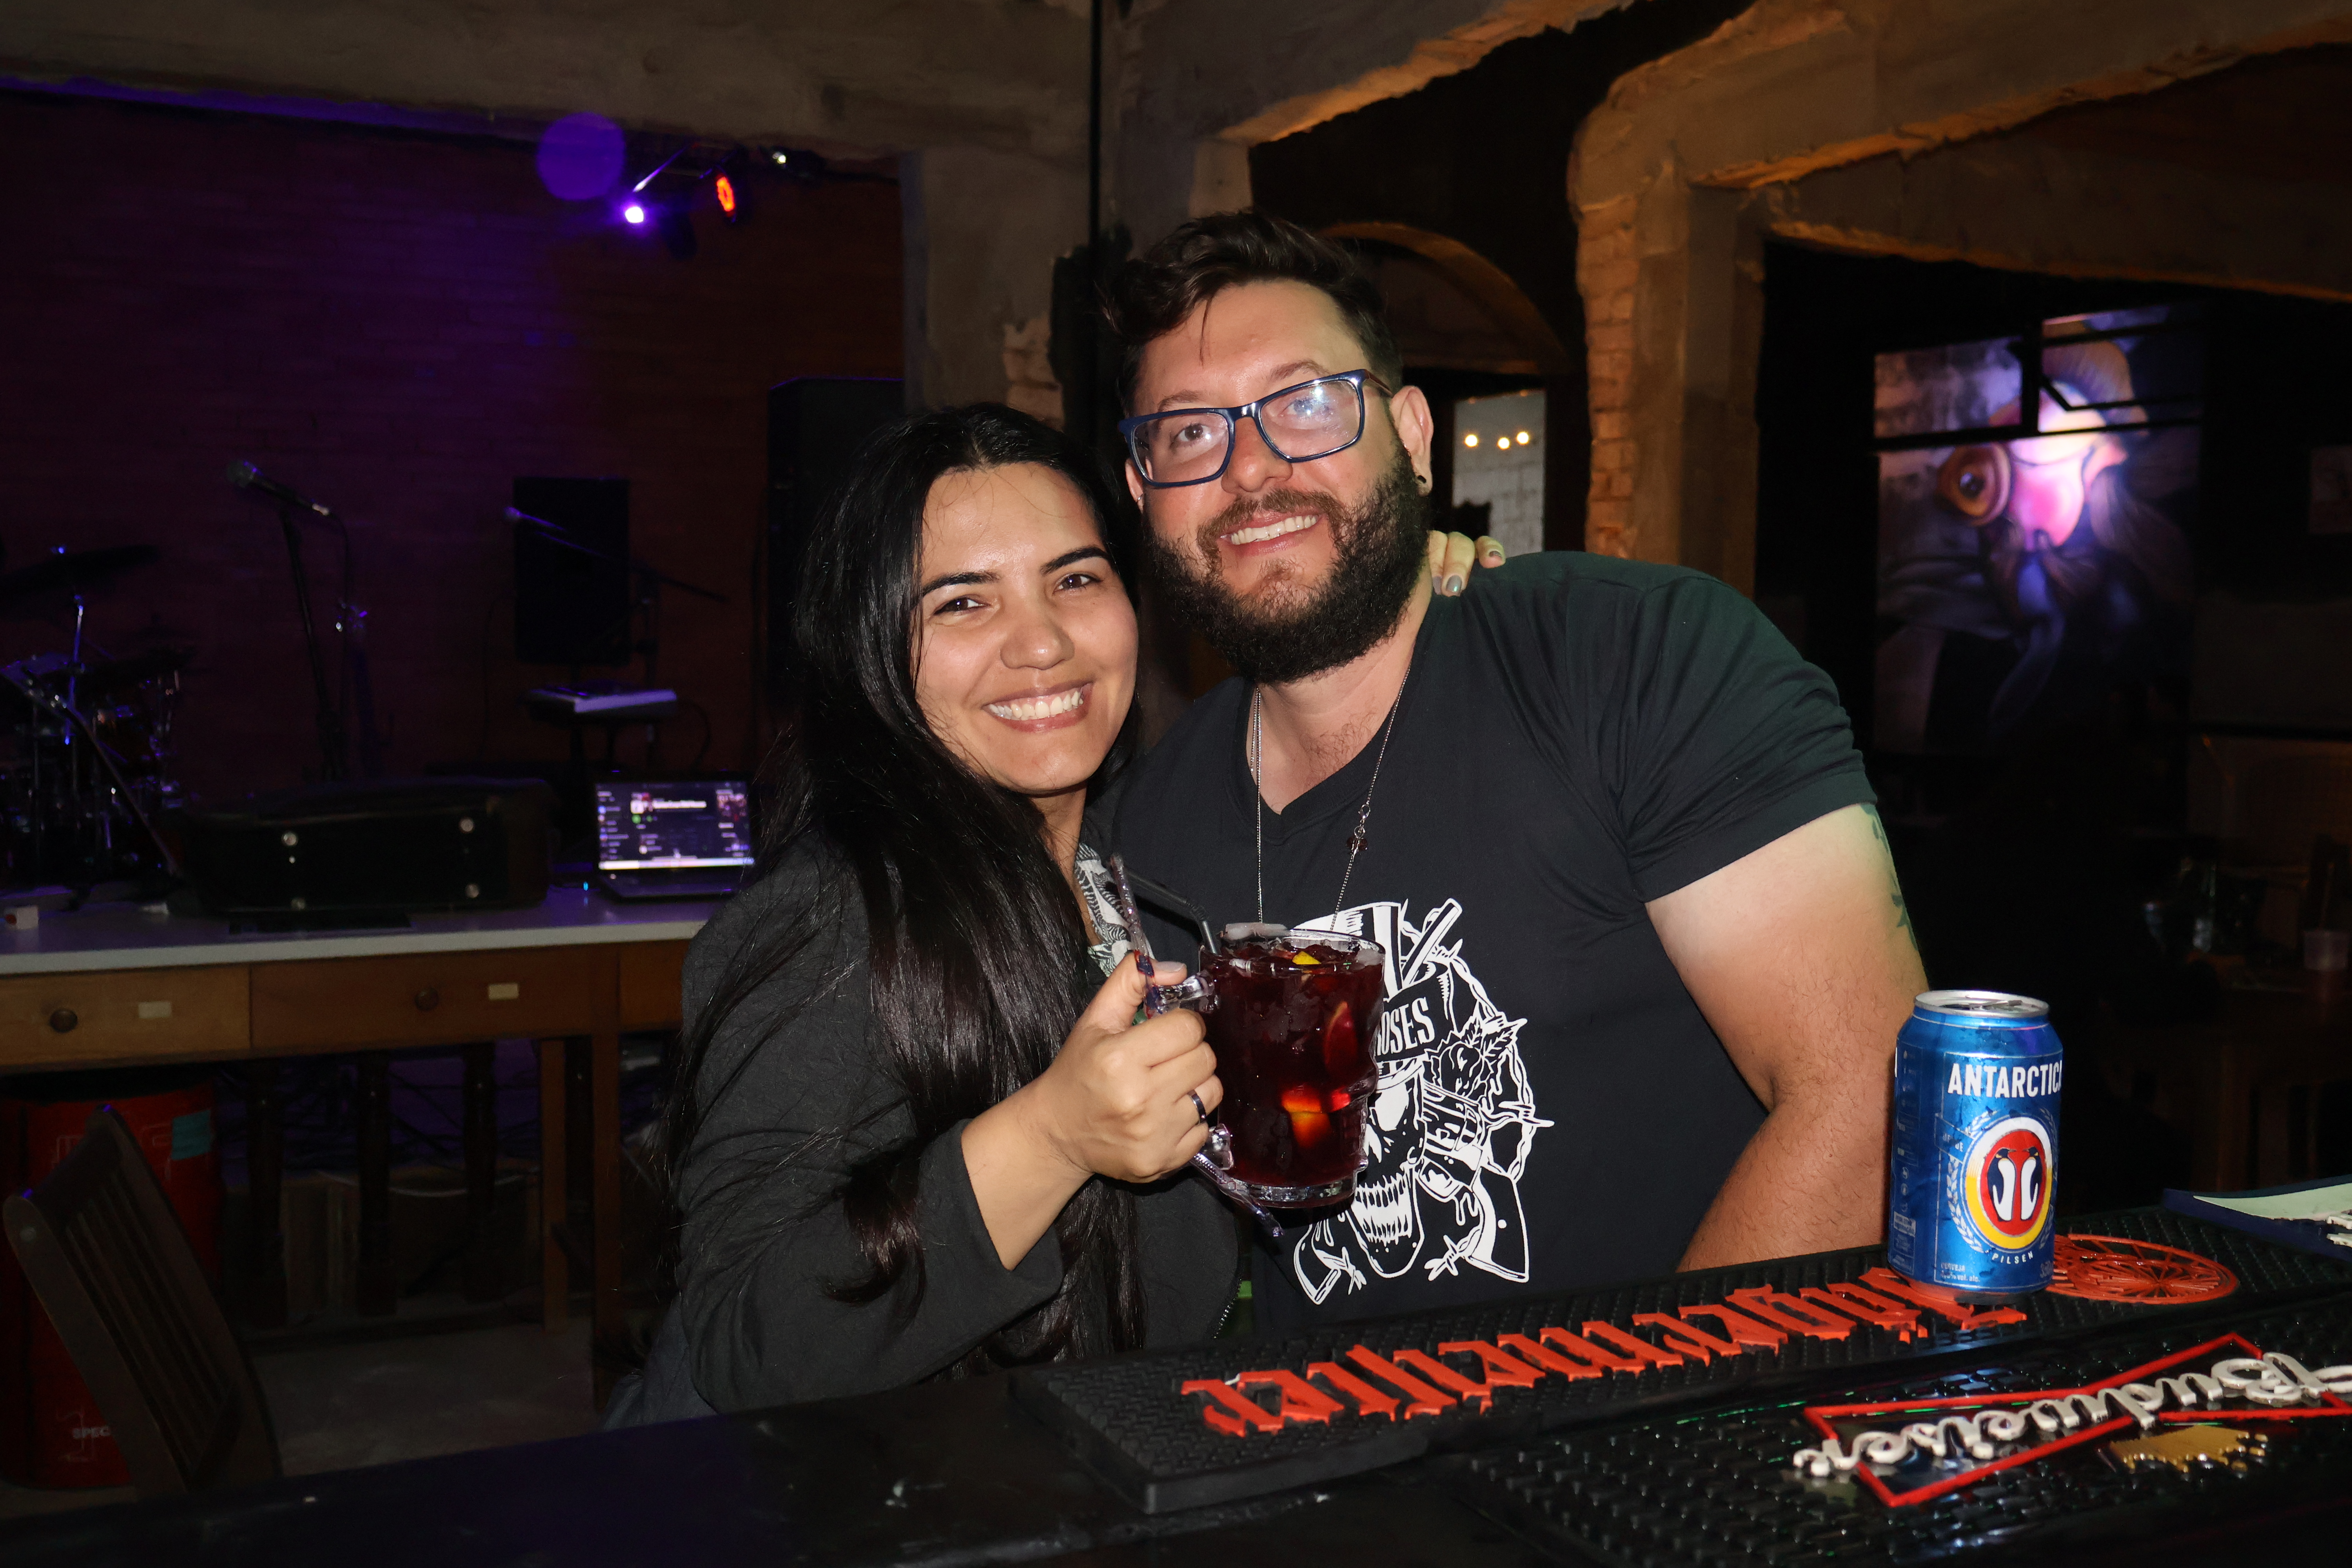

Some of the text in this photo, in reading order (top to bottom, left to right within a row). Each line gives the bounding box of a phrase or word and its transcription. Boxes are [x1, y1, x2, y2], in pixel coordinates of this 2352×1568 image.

[1377, 996, 1435, 1056] OSES
[1992, 1252, 2034, 1265] PILSEN
[1792, 1352, 2352, 1477] Budweiser
